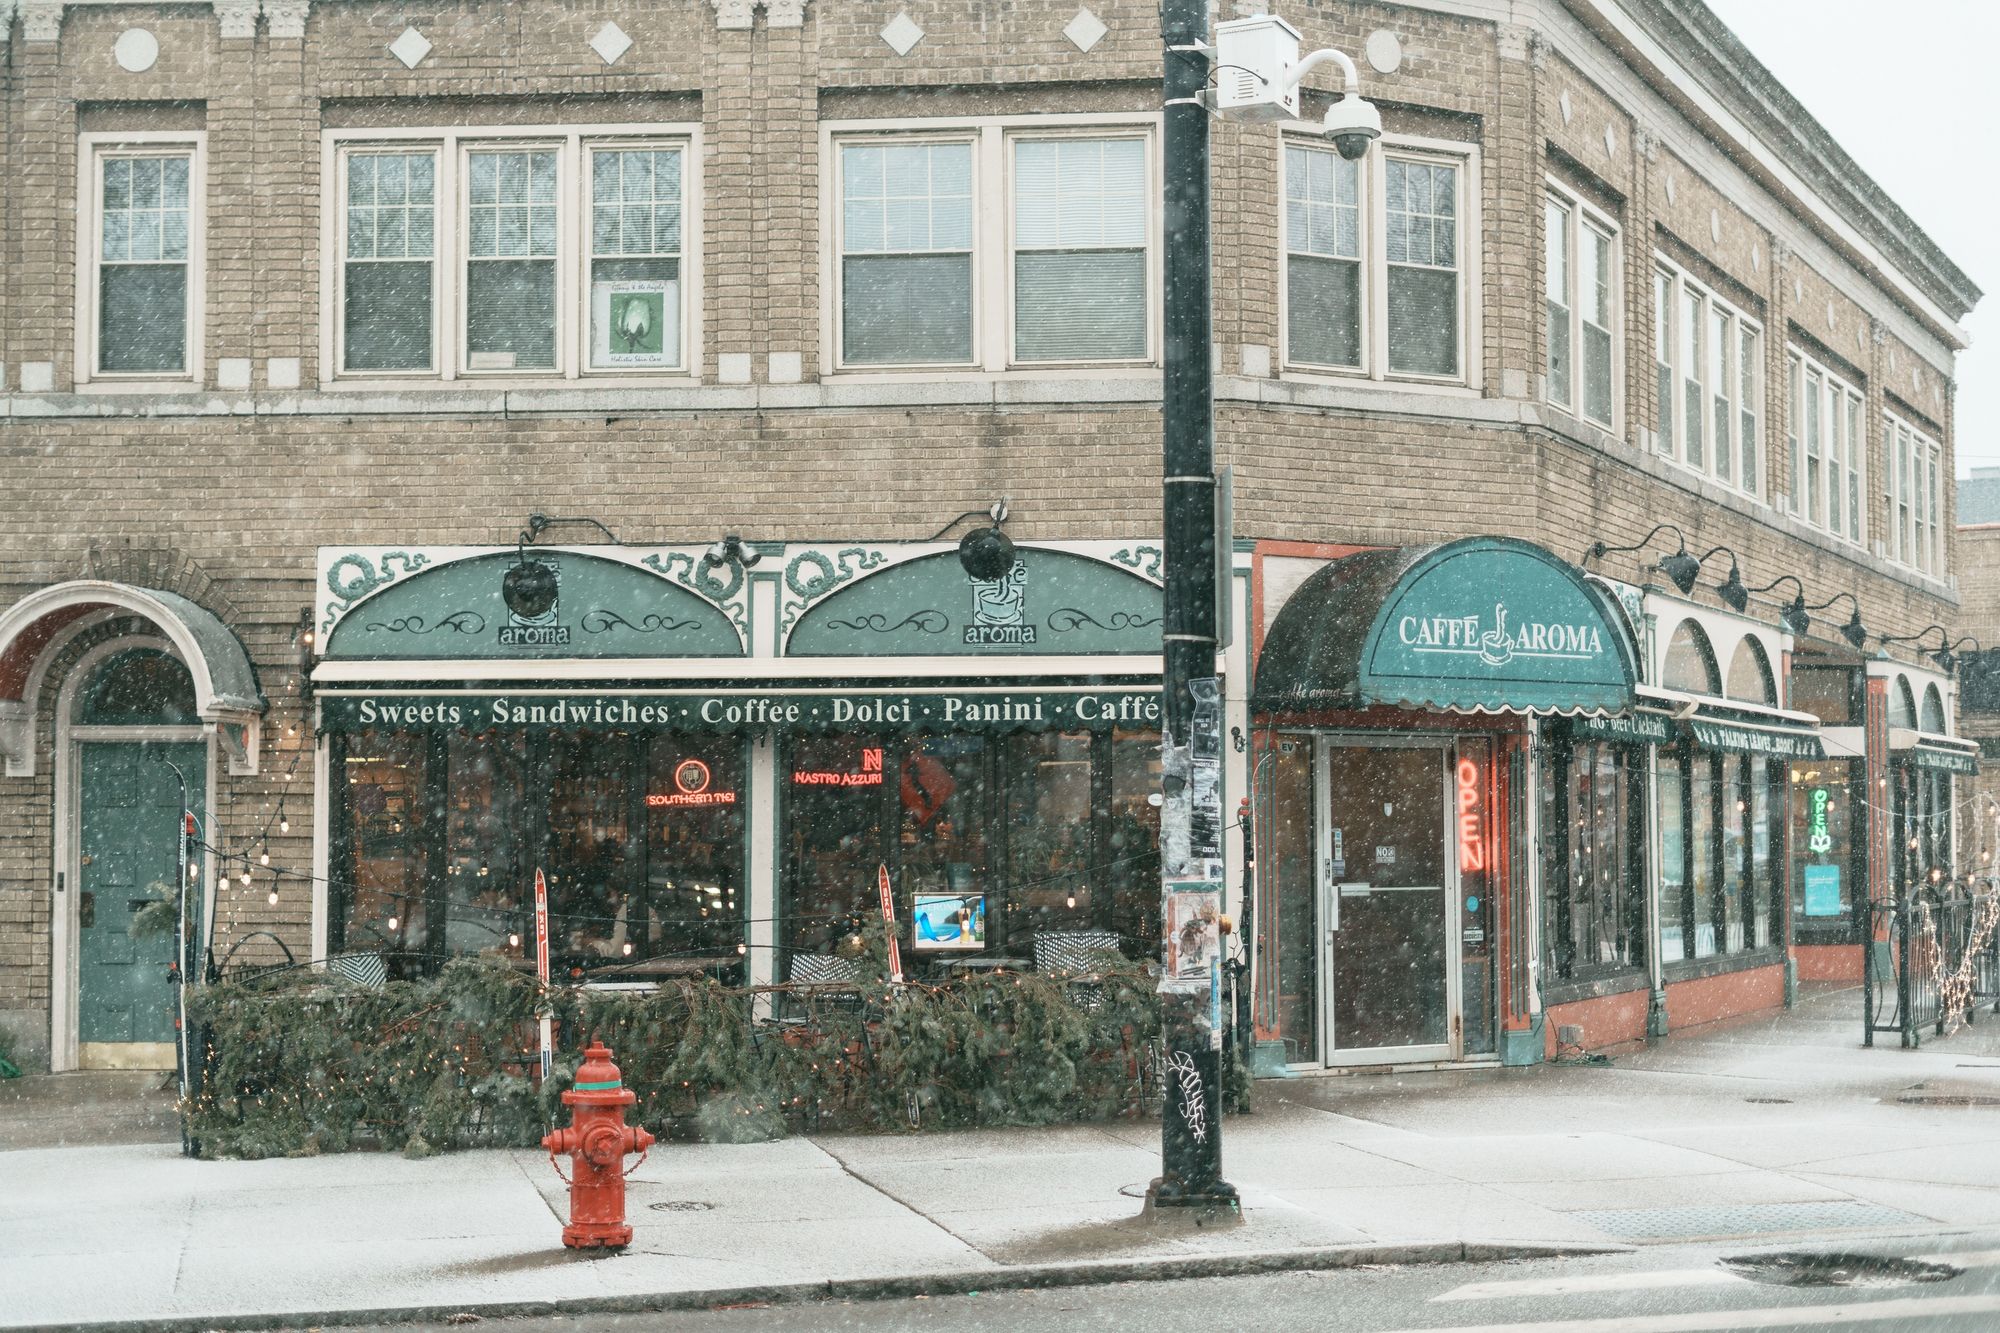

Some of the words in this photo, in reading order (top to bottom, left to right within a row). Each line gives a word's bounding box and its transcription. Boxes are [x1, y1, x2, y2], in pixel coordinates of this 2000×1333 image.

[500, 627, 570, 644] aroma
[965, 626, 1036, 643] aroma
[1399, 615, 1480, 647] CAFFÉ
[1516, 622, 1603, 652] AROMA
[359, 698, 460, 724] Sweets
[492, 697, 669, 724] Sandwiches
[700, 698, 799, 724] Coffee
[831, 698, 911, 723] Dolci
[944, 696, 1043, 722] Panini
[1075, 695, 1159, 721] Caffé
[863, 748, 883, 771] N
[794, 771, 840, 784] NASTRO
[649, 792, 713, 806] SOUTHERN
[714, 791, 736, 803] TIE
[1457, 758, 1484, 871] OPEN
[1813, 789, 1828, 838] OPEN
